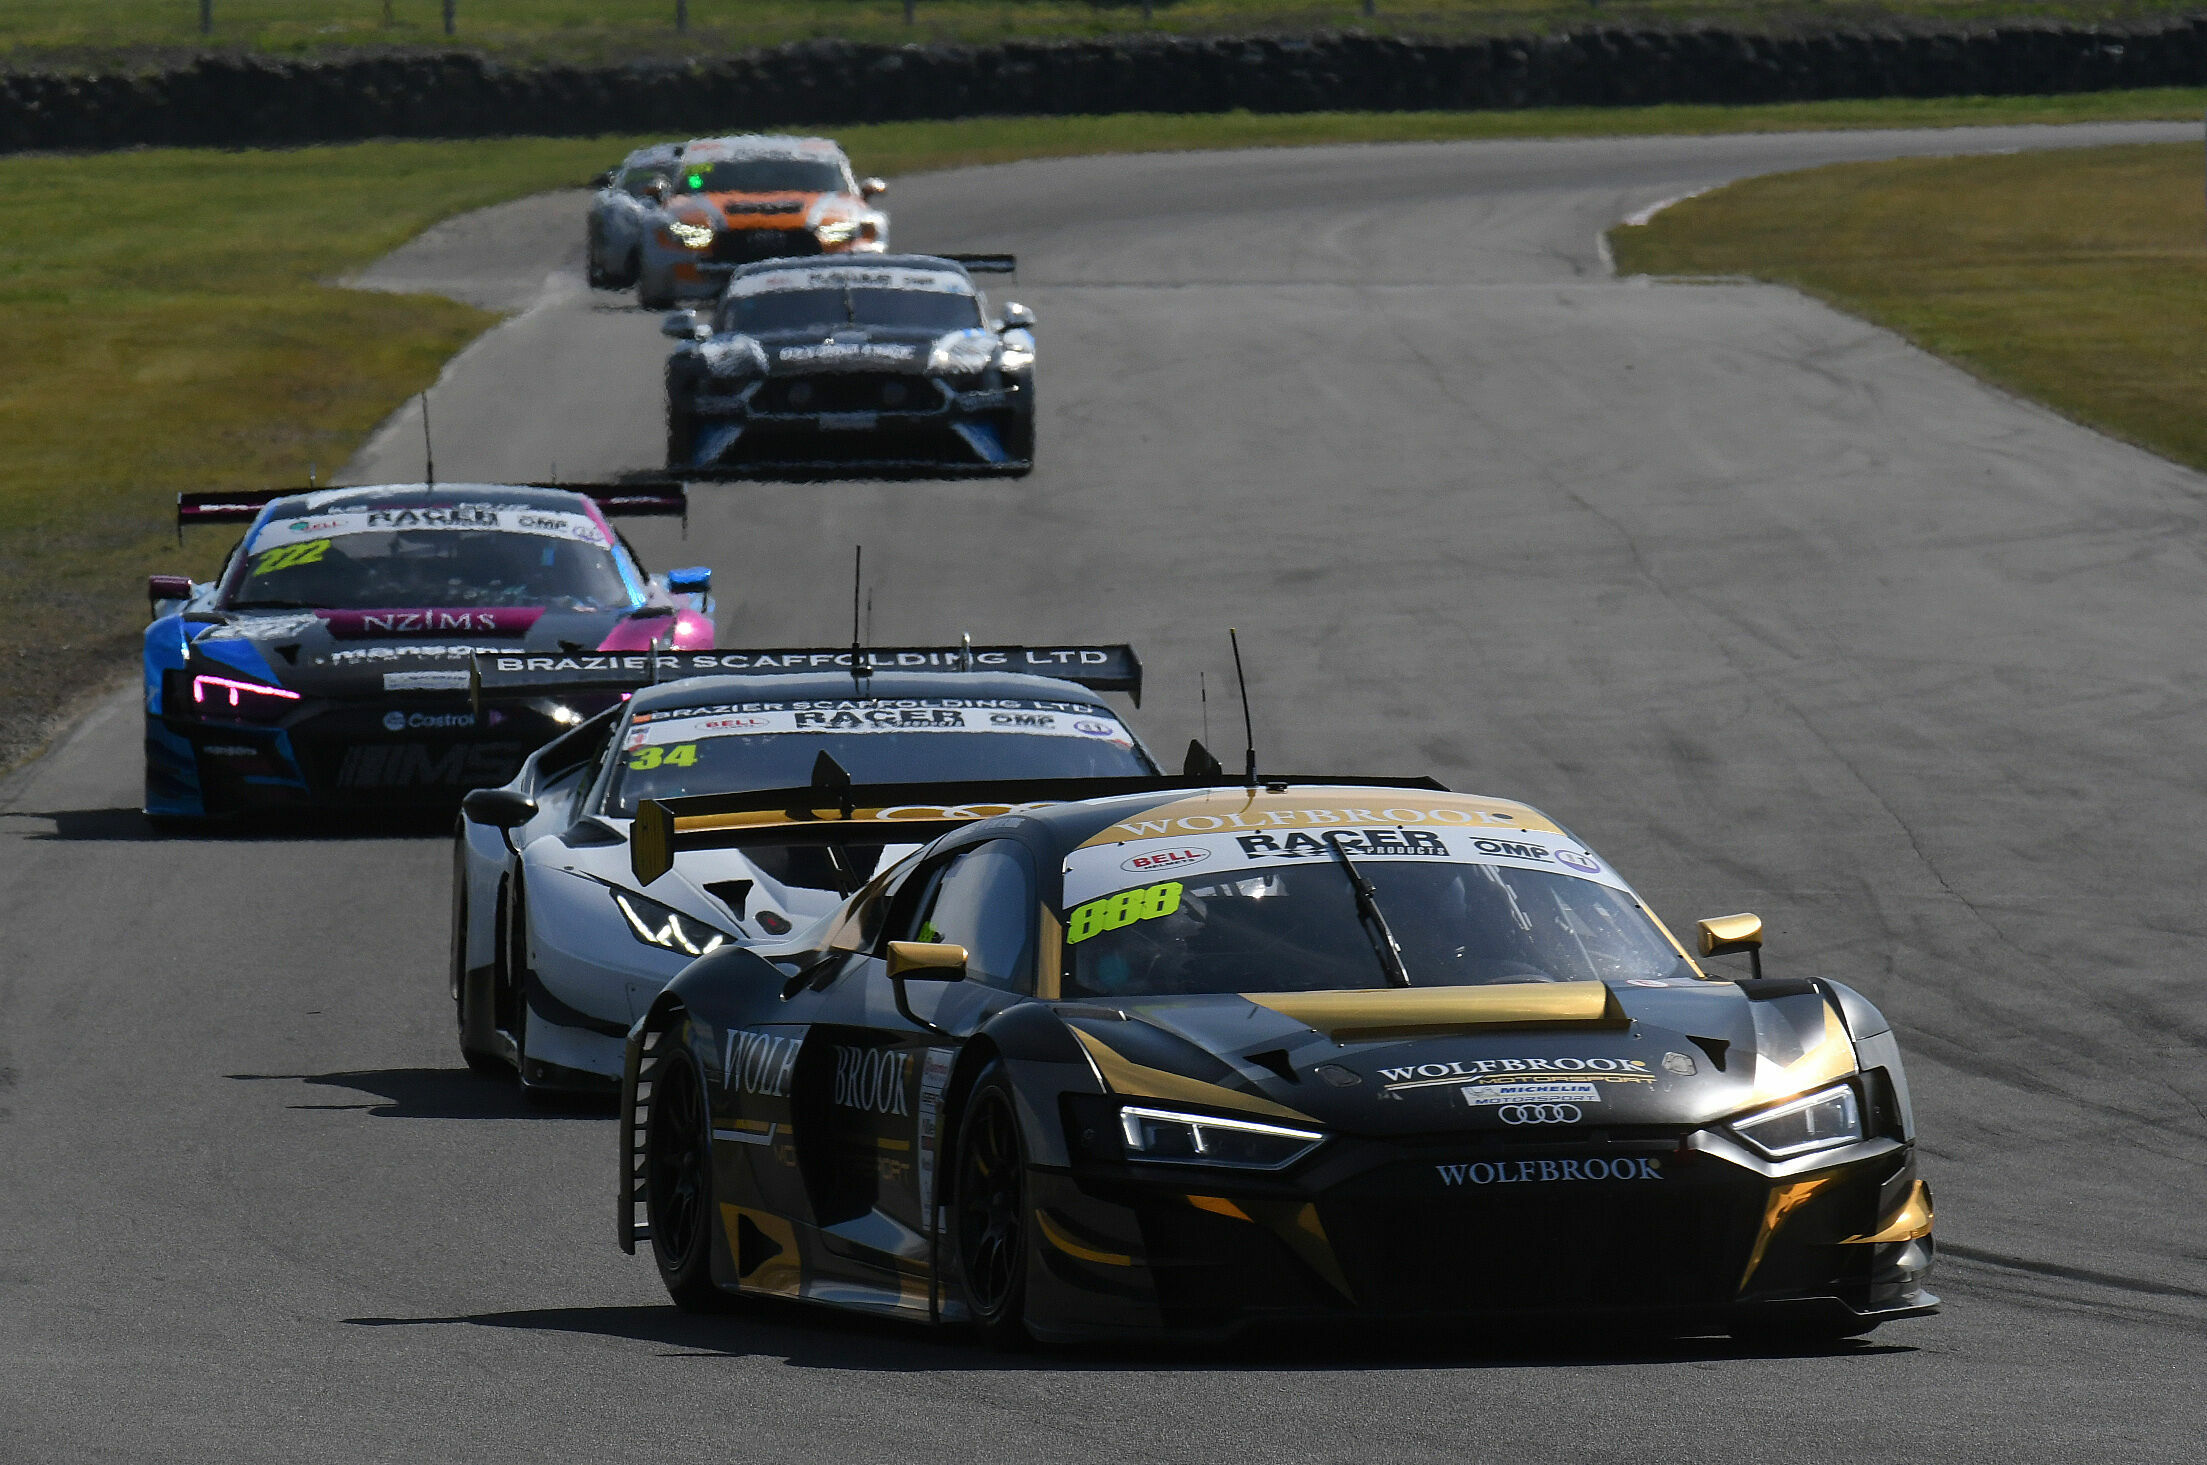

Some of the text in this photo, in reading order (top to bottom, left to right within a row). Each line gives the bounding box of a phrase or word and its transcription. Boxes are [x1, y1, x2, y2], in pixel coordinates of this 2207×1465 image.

[253, 539, 331, 576] 222
[496, 650, 1108, 672] BRAZIER SCAFFOLDING LTD
[408, 712, 476, 727] Castrol
[651, 702, 784, 720] BRAZIER
[792, 699, 1022, 713] SCAFFOLDING
[794, 709, 965, 729] RACER
[706, 718, 765, 729] BELL
[989, 713, 1055, 727] OMP
[629, 744, 698, 770] 34
[1111, 808, 1518, 836] WOLFBROOK
[1235, 829, 1450, 860] RACER
[1366, 846, 1446, 856] PRODUCTS
[1473, 840, 1550, 859] OMP
[1131, 849, 1203, 869] BELL
[1066, 881, 1184, 945] 888
[1376, 1058, 1652, 1083] WOLFBROOK
[1479, 1076, 1657, 1085] MOTORSPORT
[1476, 1094, 1596, 1105] MOTORSPORT
[1500, 1085, 1591, 1094] MICHELIN
[1435, 1158, 1665, 1187] WOLFBROOK
